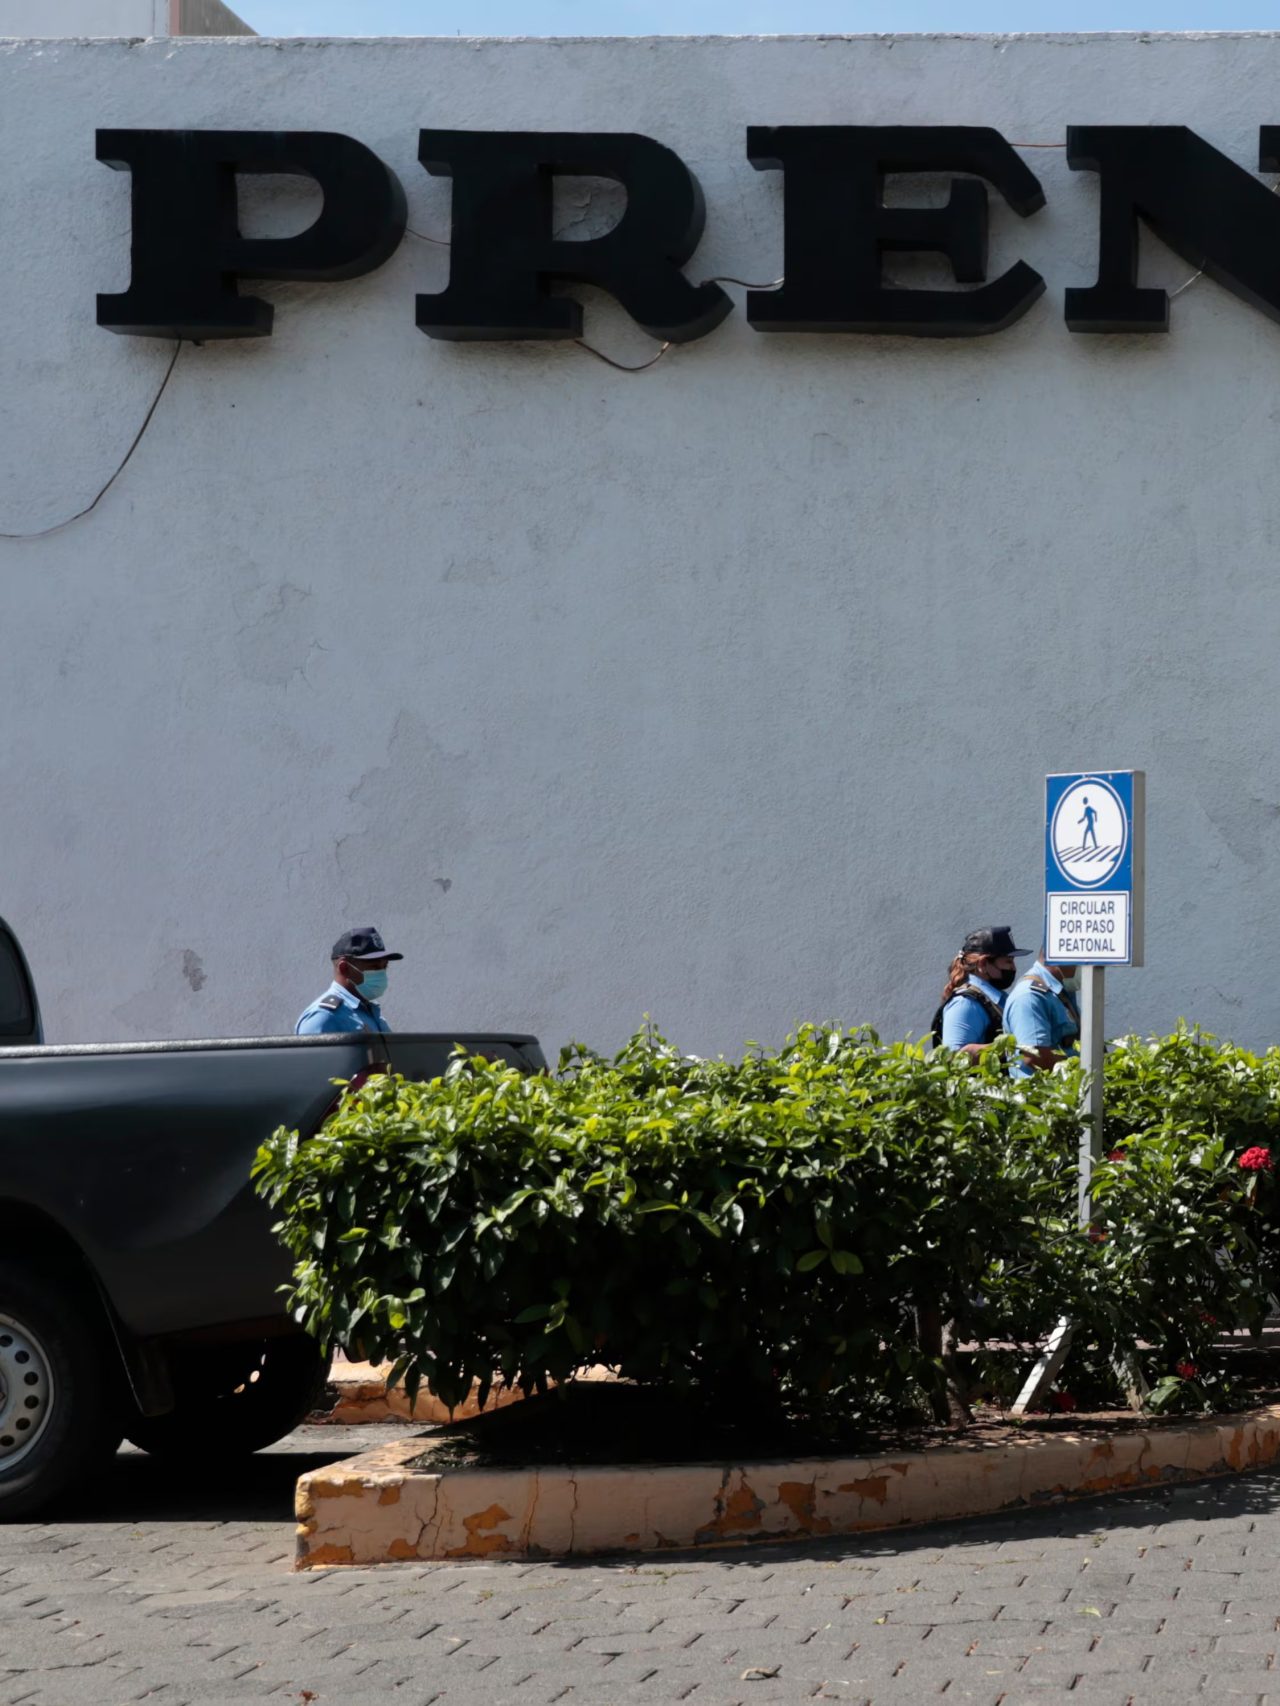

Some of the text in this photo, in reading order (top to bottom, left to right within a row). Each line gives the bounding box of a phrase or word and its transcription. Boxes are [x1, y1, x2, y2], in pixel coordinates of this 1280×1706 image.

[1060, 900, 1115, 915] CIRCULAR
[1060, 919, 1114, 934] POR PASO
[1059, 938, 1115, 952] PEATONAL
